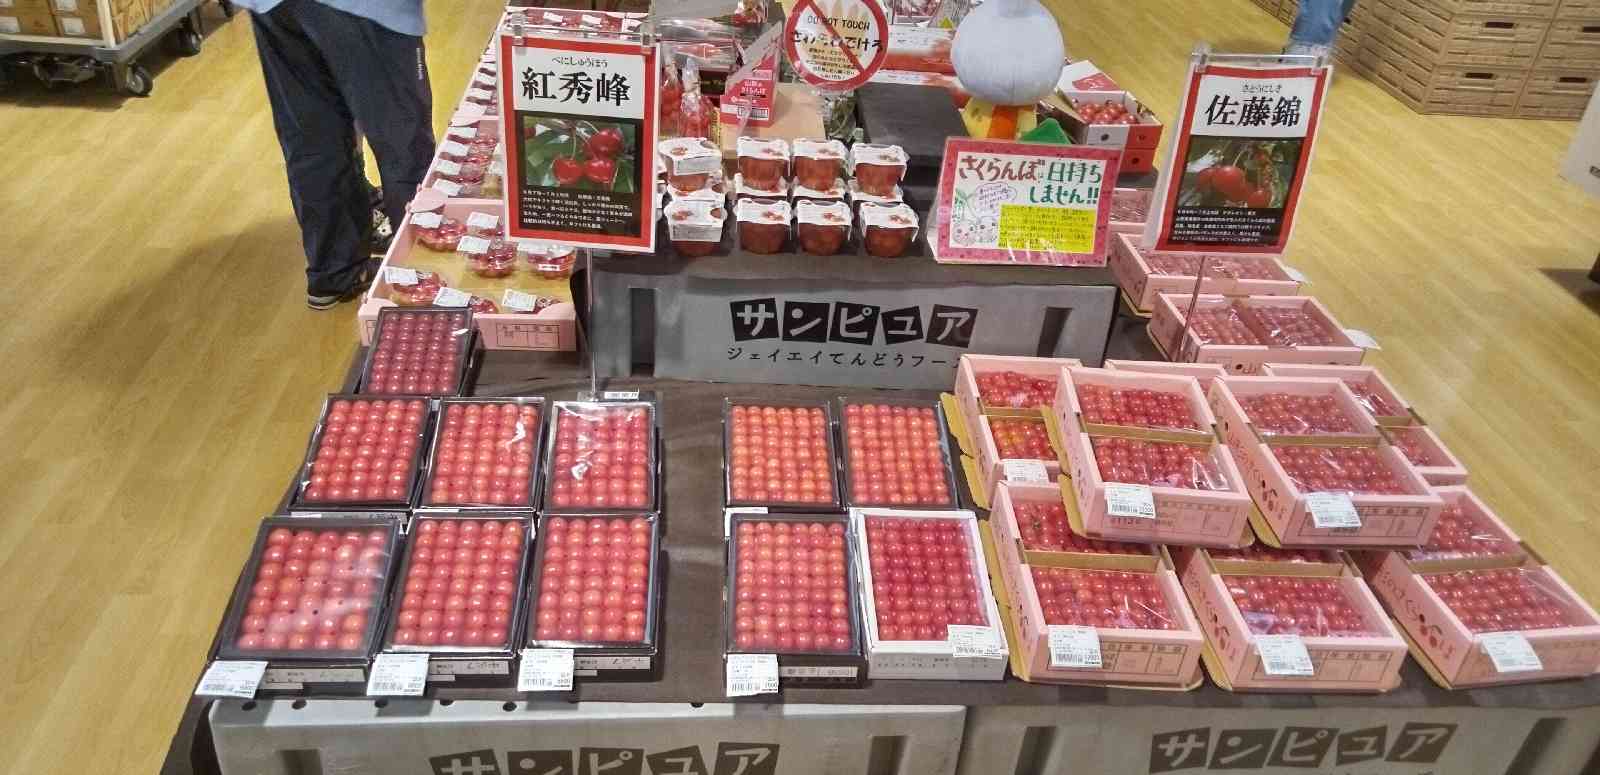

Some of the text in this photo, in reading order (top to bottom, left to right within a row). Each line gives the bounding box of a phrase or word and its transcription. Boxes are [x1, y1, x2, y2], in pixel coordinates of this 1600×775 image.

[842, 19, 871, 31] TOUCH
[551, 55, 608, 68] べにしゅうほう
[521, 66, 632, 107] 紅秀峰
[1205, 94, 1302, 127] 佐藤錦
[734, 301, 974, 343] サンピュア
[727, 346, 961, 370] ジェイエイてんどうフー
[1155, 725, 1452, 769] サンピュア
